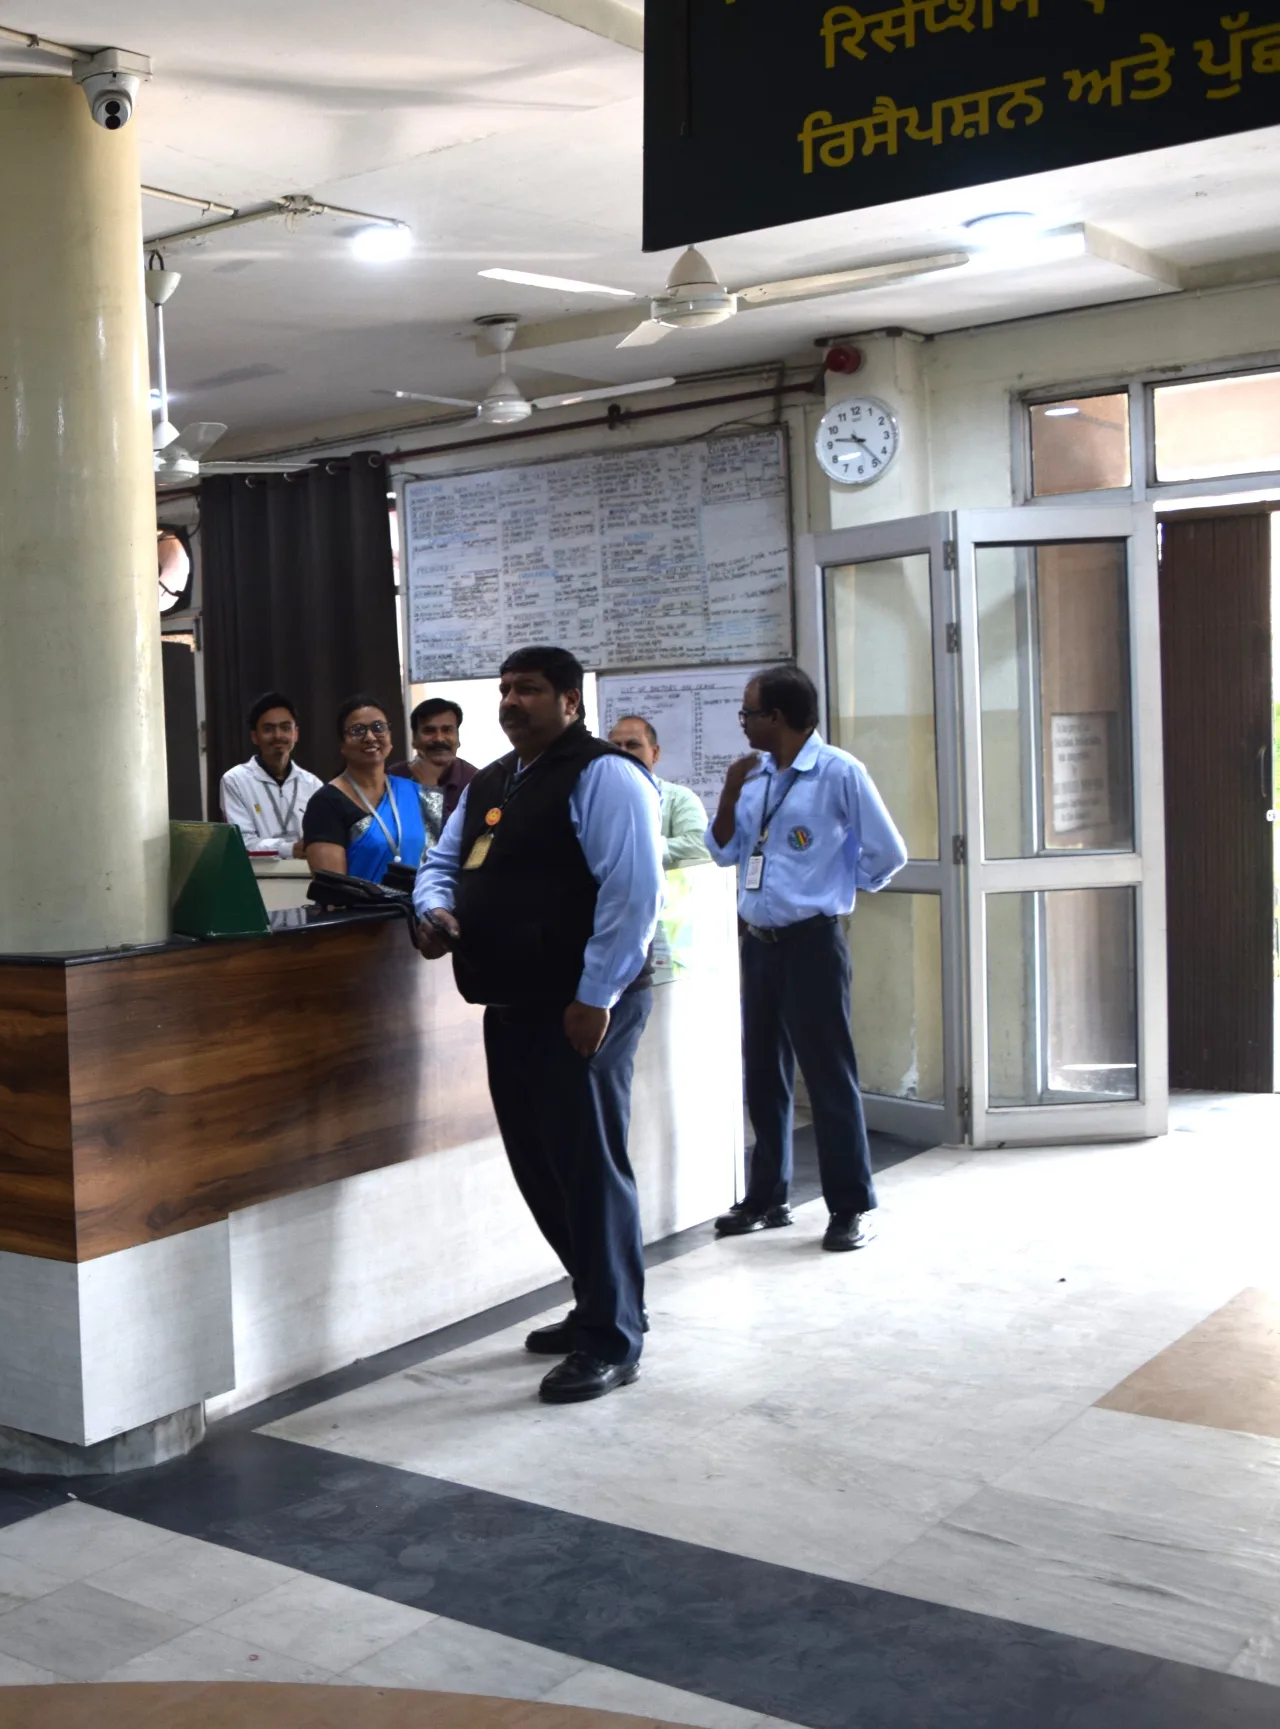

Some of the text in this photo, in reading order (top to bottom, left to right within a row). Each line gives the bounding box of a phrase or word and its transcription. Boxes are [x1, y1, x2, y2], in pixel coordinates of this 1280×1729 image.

[797, 77, 1046, 174] ਰਿਸੈਪਸ਼ਨ
[1064, 33, 1176, 107] ਅਤੇ
[850, 406, 861, 416] 12
[868, 408, 873, 416] 1
[837, 413, 847, 422] 11
[877, 416, 885, 426] 2
[828, 426, 839, 435] 10
[883, 431, 890, 440] 3
[826, 441, 834, 450] 9
[880, 446, 887, 455] 4
[831, 455, 839, 464] 8
[871, 459, 879, 468] 5
[843, 464, 850, 473] 7
[857, 466, 865, 474] 6
